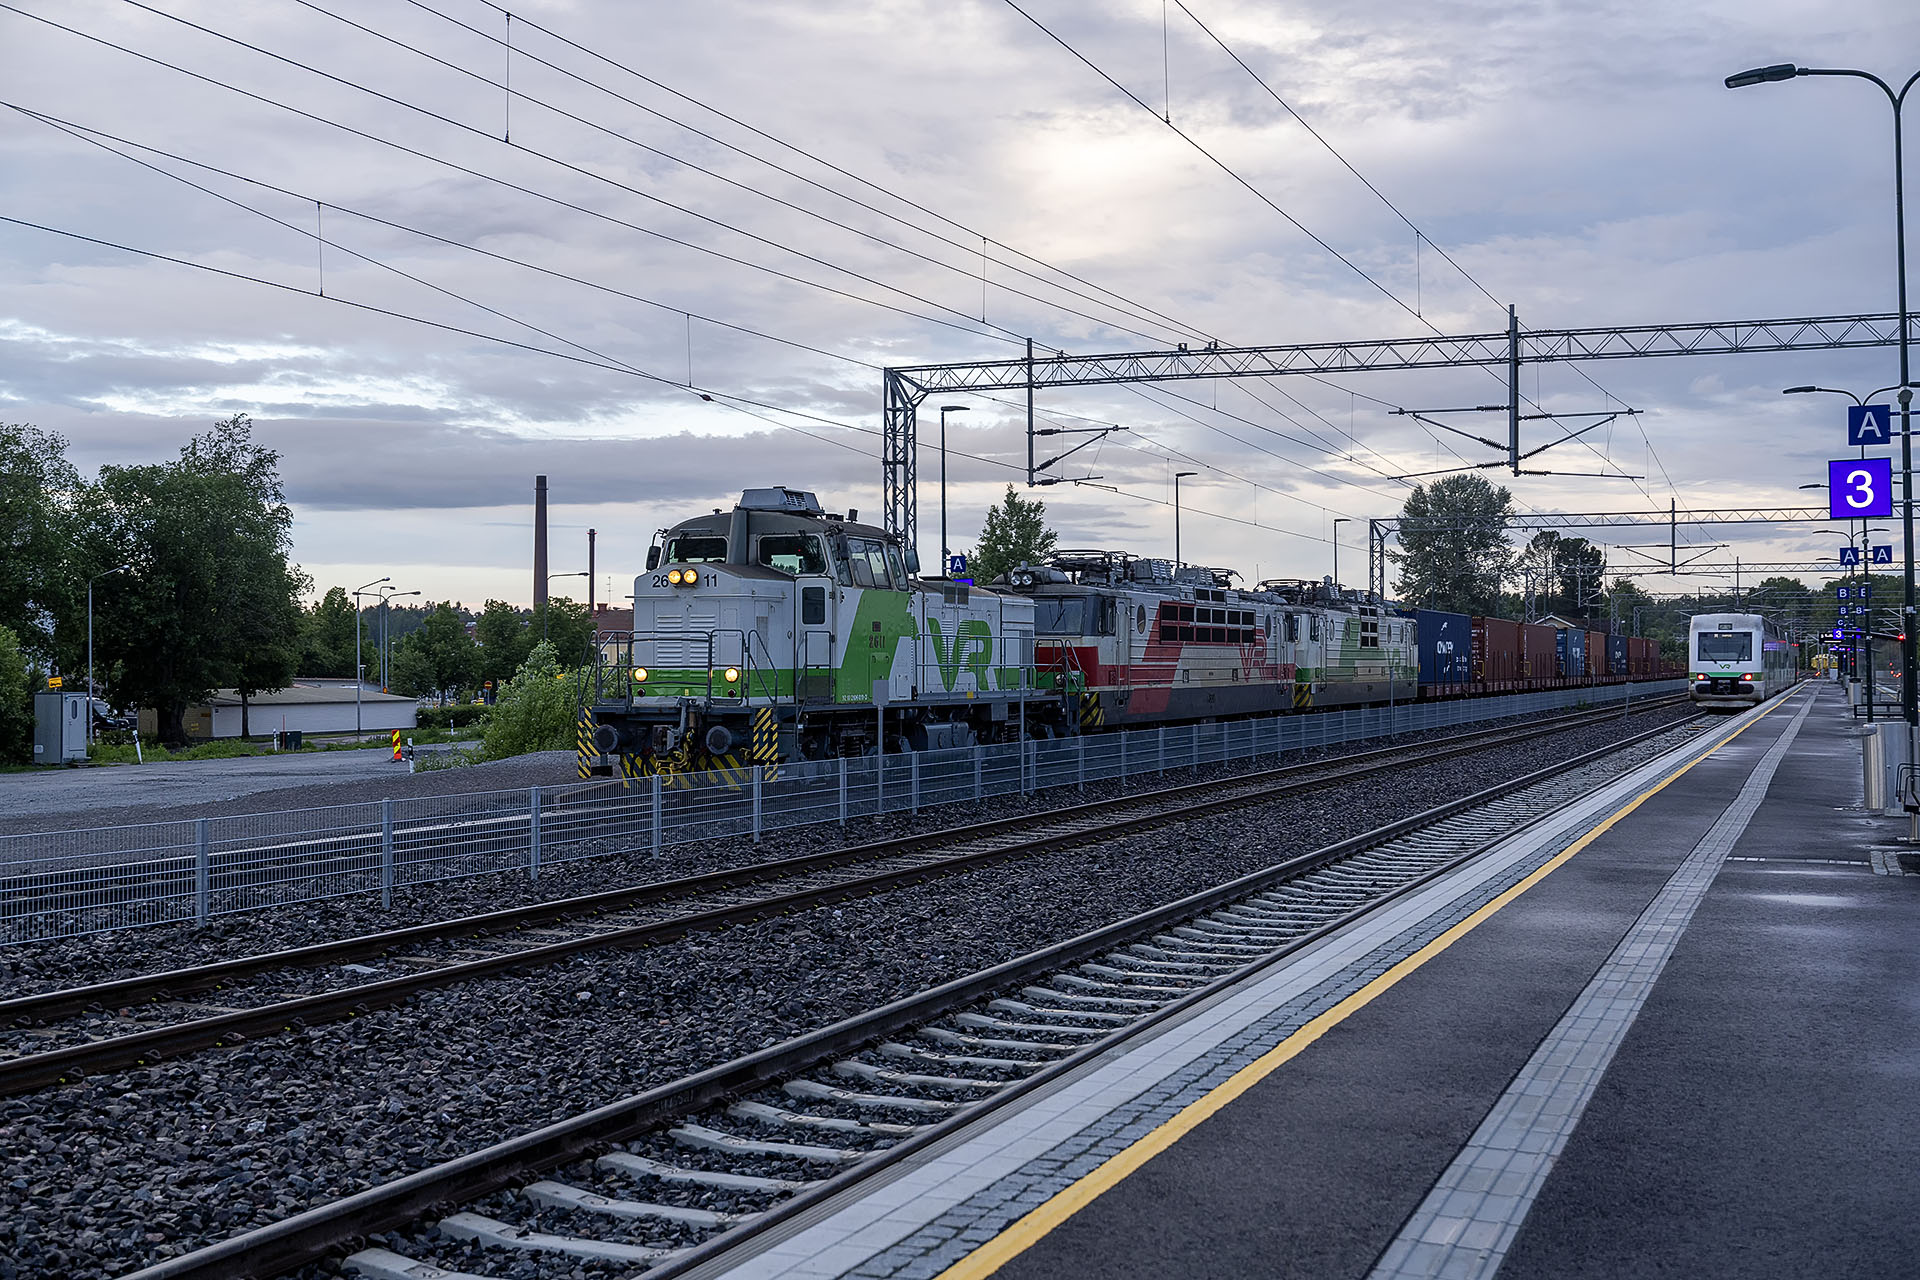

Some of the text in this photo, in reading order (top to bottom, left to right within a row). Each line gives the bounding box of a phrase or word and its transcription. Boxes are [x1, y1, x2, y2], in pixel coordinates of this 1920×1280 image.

[1857, 411, 1882, 438] A
[1845, 469, 1875, 509] 3
[1844, 550, 1856, 563] A
[1876, 548, 1888, 561] A
[953, 558, 963, 570] A
[652, 573, 718, 588] 26 11
[1839, 588, 1848, 598] B
[1840, 606, 1847, 615] B
[1835, 630, 1842, 638] 3
[869, 634, 886, 648] 2611
[927, 617, 993, 692] VR
